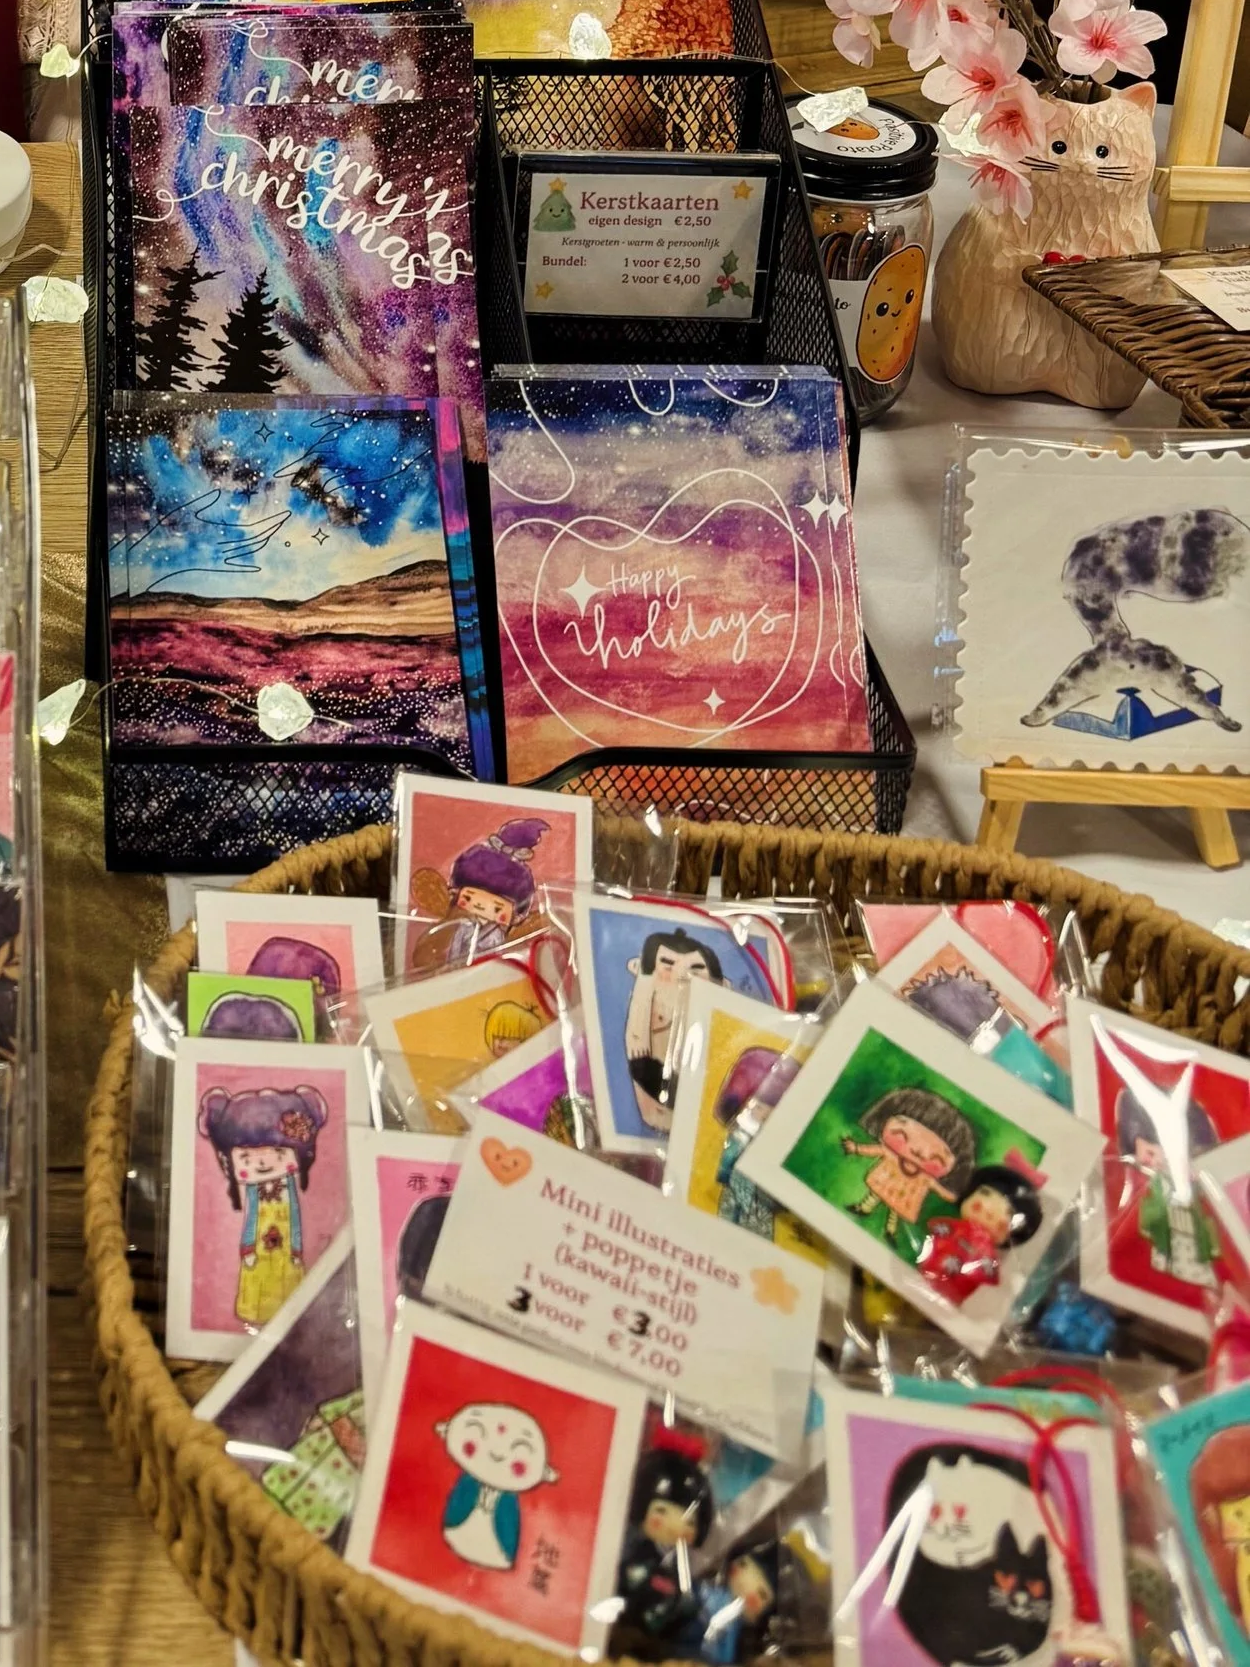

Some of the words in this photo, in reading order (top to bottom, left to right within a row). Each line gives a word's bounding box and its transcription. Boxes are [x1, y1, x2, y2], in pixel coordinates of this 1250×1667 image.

[266, 135, 420, 227] merry
[579, 191, 720, 212] Kerstkaarten
[200, 150, 432, 290] christmas
[588, 216, 620, 229] eigen
[623, 214, 663, 229] design
[561, 236, 621, 248] Kerstgroeten
[627, 238, 654, 248] warm
[656, 238, 666, 248] &
[667, 238, 721, 251] persoonlijk
[541, 255, 588, 268] Bundel:
[623, 257, 629, 268] 1
[632, 258, 661, 269] voor
[621, 273, 629, 285] 2
[632, 275, 660, 285] voor
[605, 561, 697, 611] Happy
[563, 598, 792, 670] holidays
[539, 1177, 603, 1226] Mini
[606, 1208, 742, 1291] illustraties
[581, 1227, 700, 1300] poppetje
[538, 1270, 591, 1306] voor
[535, 1300, 587, 1334] voor
